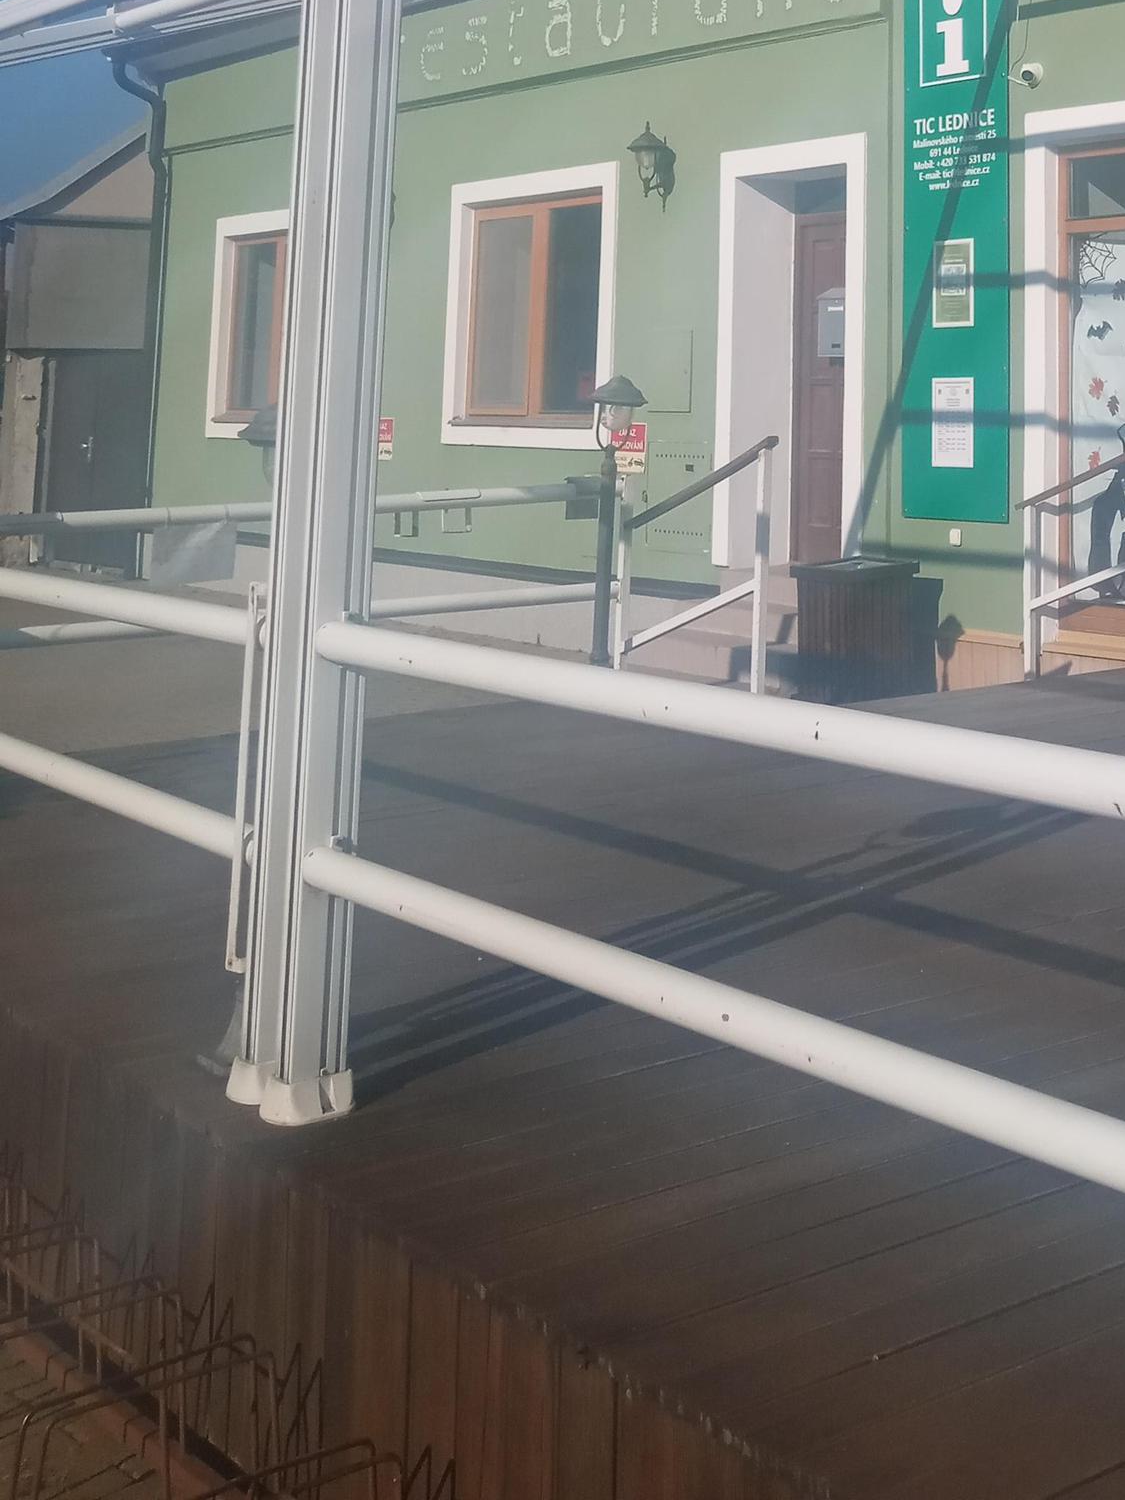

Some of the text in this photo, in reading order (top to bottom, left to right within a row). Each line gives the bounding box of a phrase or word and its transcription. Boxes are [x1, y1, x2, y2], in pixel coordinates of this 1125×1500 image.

[913, 108, 995, 136] TIC LEDNICE
[987, 129, 997, 140] 25
[929, 147, 942, 158] 691
[942, 146, 952, 157] 44
[982, 152, 996, 163] 874
